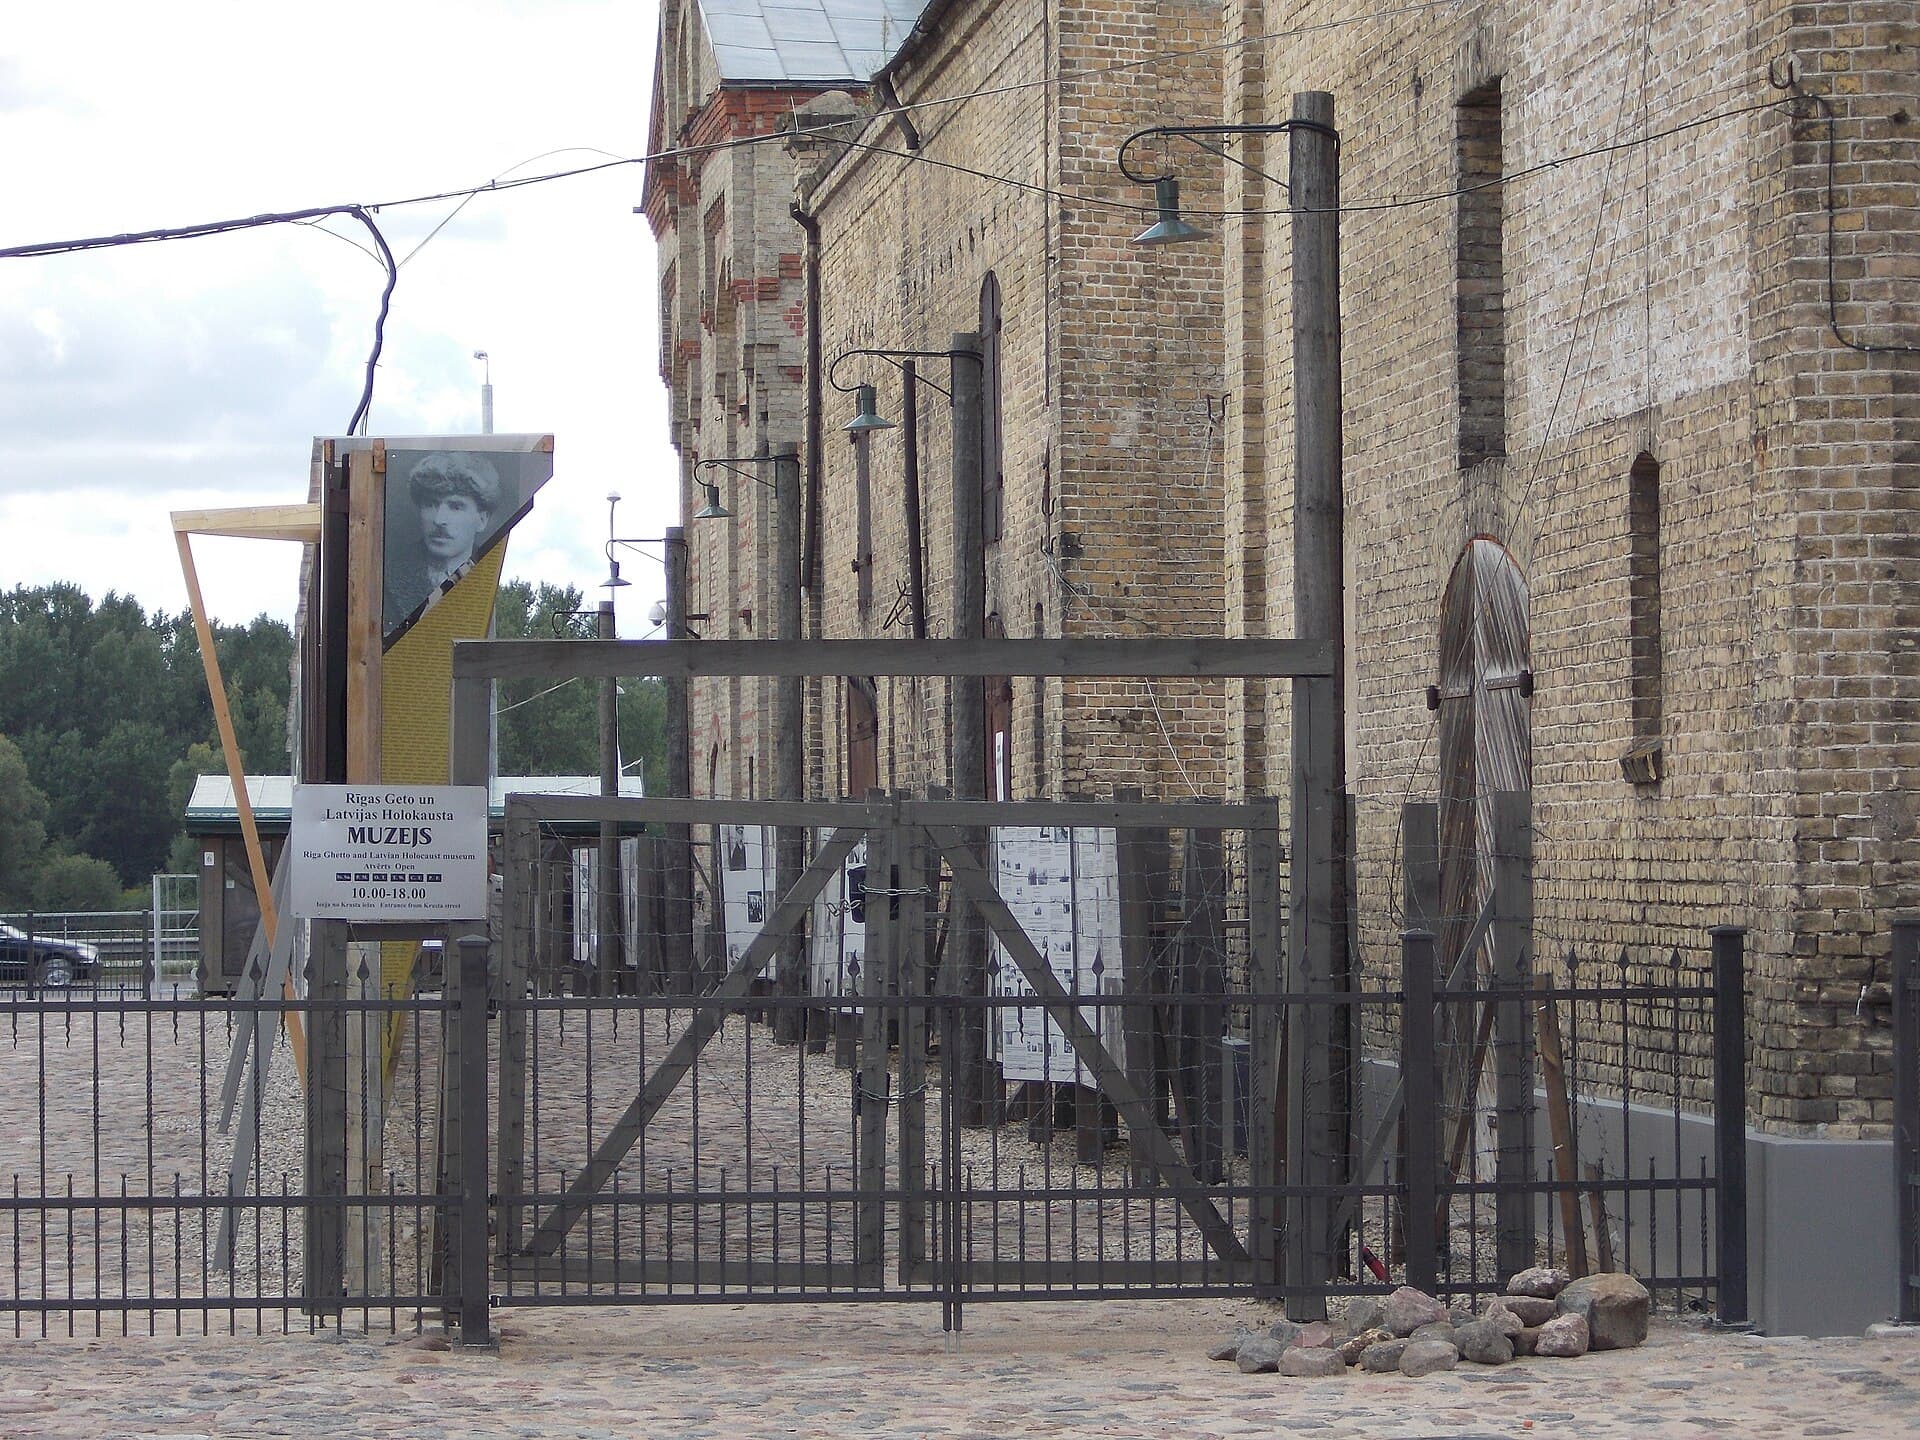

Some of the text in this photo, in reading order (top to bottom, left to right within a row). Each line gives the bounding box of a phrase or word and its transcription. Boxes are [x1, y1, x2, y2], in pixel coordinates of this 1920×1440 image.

[346, 793, 434, 806] Rīgas Geto un
[326, 809, 453, 822] Latvijas Holokausta
[348, 827, 432, 848] MUZEJS
[303, 851, 321, 860] Riga
[395, 863, 415, 871] Open
[352, 888, 426, 899] 10.00-18.00
